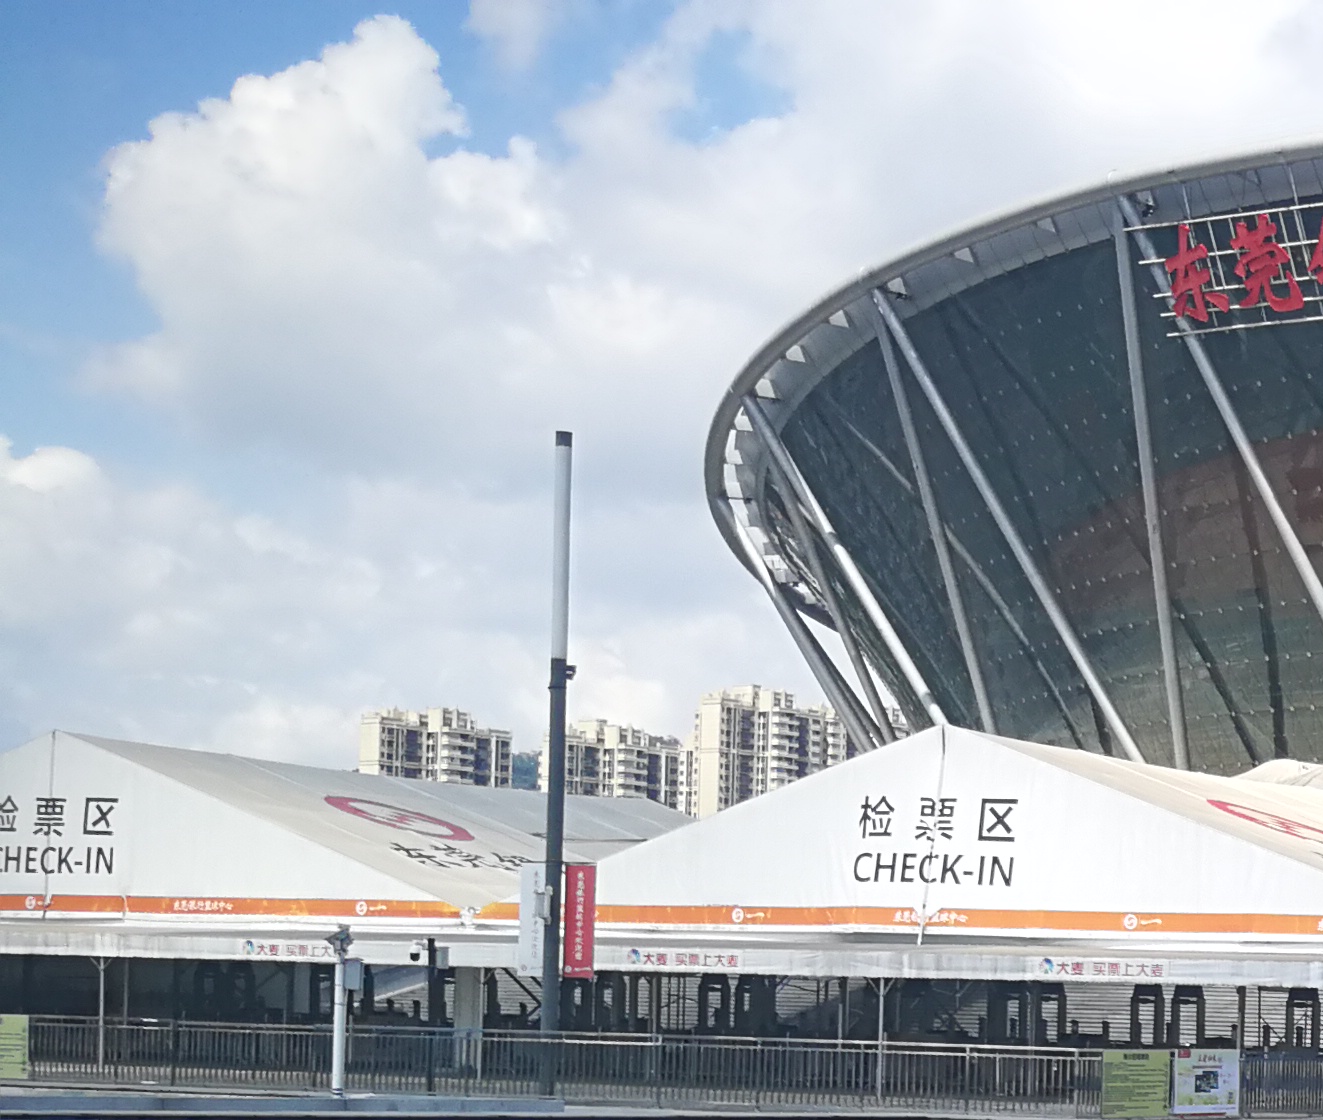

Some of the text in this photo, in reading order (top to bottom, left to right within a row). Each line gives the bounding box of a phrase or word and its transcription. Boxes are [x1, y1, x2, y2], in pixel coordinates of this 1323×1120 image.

[859, 795, 1018, 842] 检票区
[0, 846, 114, 874] HECK-IN
[853, 852, 1014, 887] CHECK-IN
